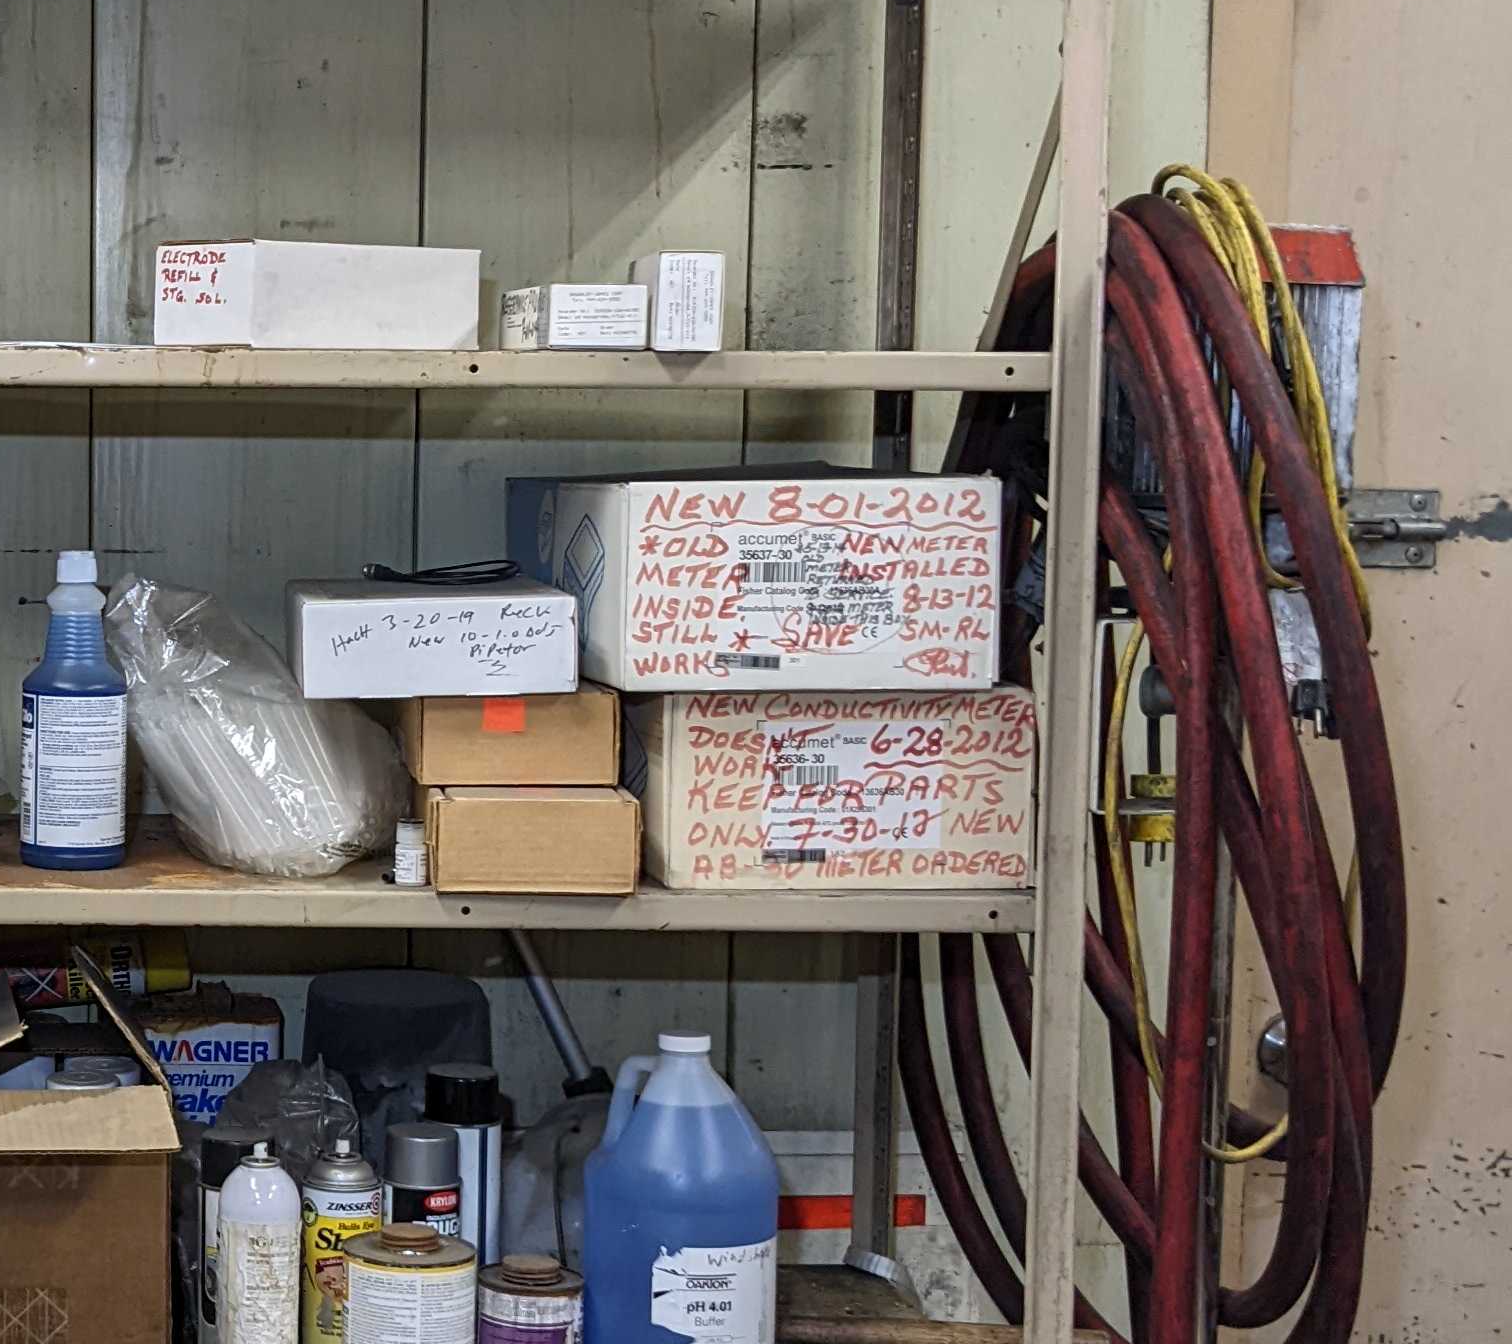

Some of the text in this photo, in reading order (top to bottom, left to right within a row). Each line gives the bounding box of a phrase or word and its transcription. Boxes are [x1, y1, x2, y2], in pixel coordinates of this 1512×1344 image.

[161, 250, 226, 265] ELECTRODE
[161, 268, 201, 283] REFILL
[162, 286, 187, 303] STG.
[644, 485, 986, 523] NEW 8-01-2012
[738, 533, 836, 546] accumet BASIC
[843, 532, 988, 555] NEW METER
[738, 550, 792, 561] 35637-30
[636, 562, 750, 591] METER
[839, 556, 990, 582] INSTALLED
[764, 587, 796, 596] Catalog
[902, 583, 996, 613] 8-13-12
[632, 610, 862, 650] STILL SAVE
[633, 649, 730, 677] WORKS
[685, 693, 1037, 728] NEW CONDUCTIVITY METER
[842, 737, 867, 745] BASIC
[870, 724, 1031, 757] 6-28-2012
[694, 752, 793, 785] WORK
[688, 778, 785, 813] KEEP
[865, 770, 1004, 806] PARTS
[950, 808, 1025, 836] NEW
[816, 848, 904, 878] METER
[912, 850, 1027, 877] ORDERED
[149, 1040, 268, 1063] WAGNER
[165, 1070, 234, 1088] remium
[172, 1088, 226, 1113] rake
[326, 1201, 373, 1212] ZINSSER
[687, 1301, 732, 1314] pH 4.01
[694, 1316, 726, 1327] Buffer
